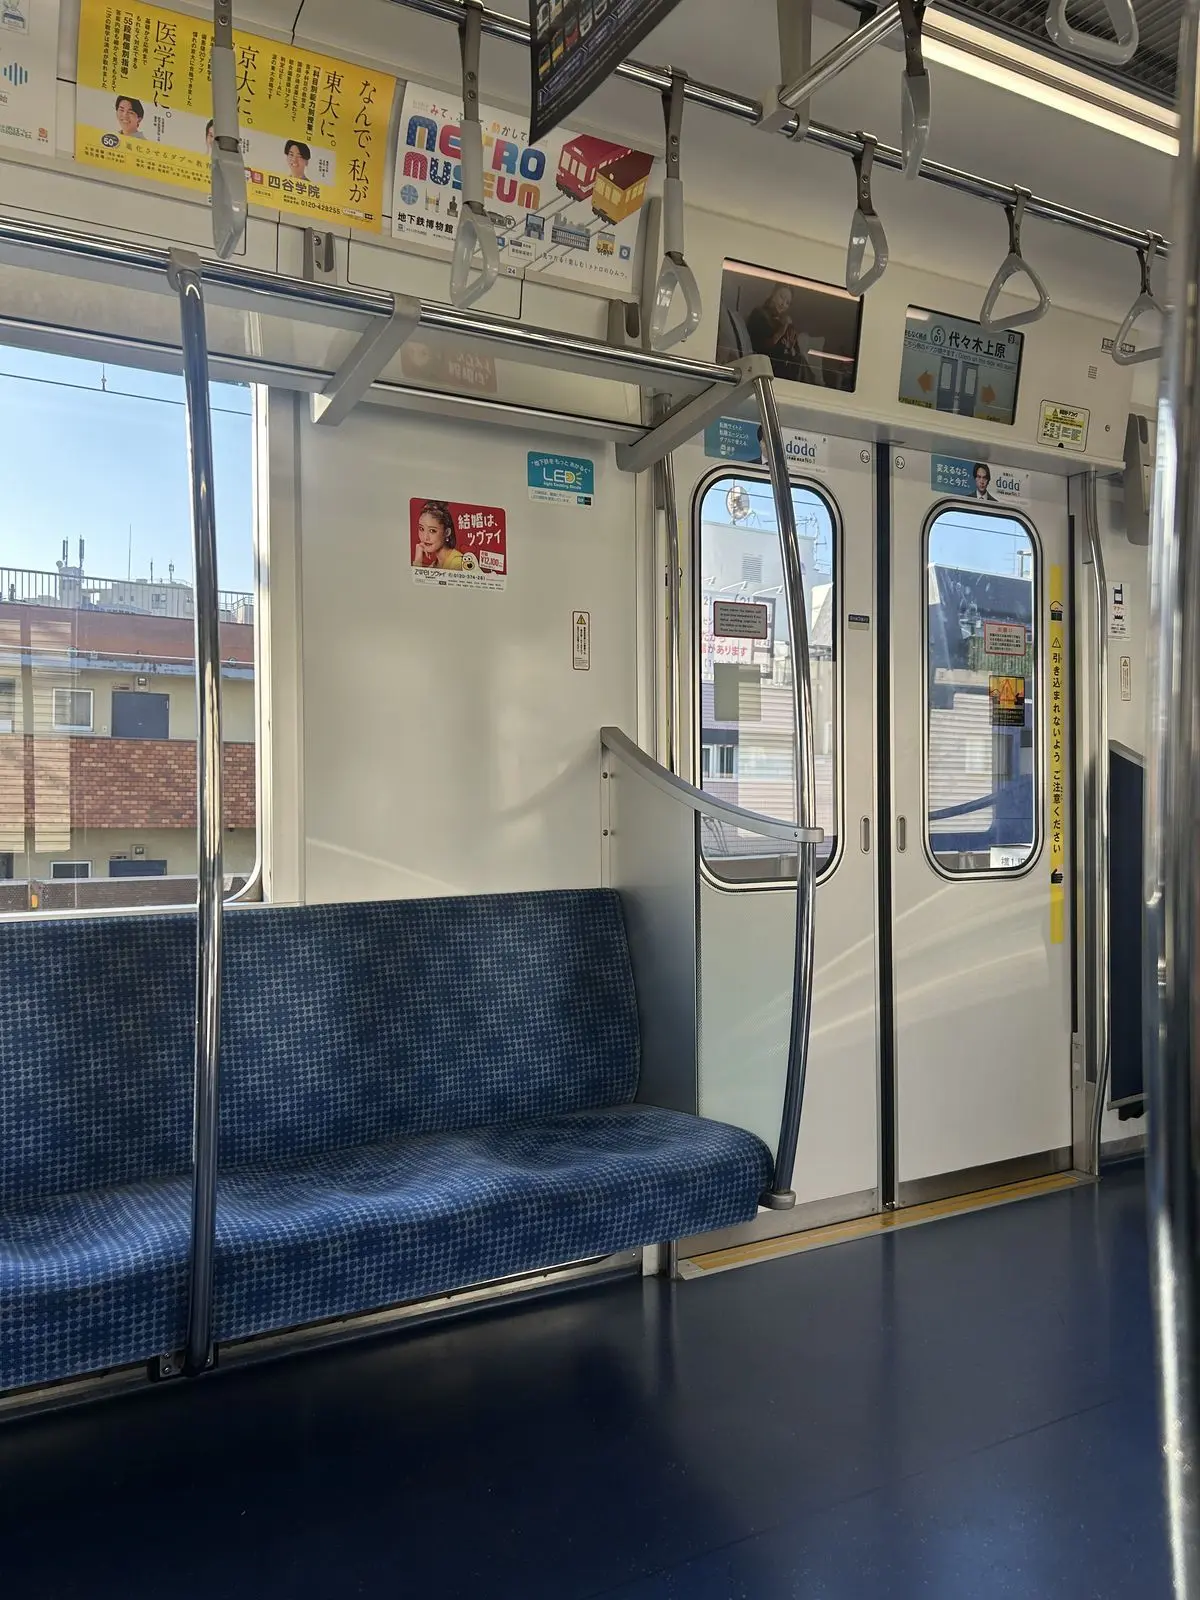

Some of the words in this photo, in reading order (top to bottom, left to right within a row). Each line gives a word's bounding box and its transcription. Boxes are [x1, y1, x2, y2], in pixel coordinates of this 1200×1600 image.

[151, 20, 177, 119] 医学部に。
[236, 46, 260, 125] 京大に。
[320, 71, 344, 147] 東大に。
[349, 80, 377, 203] なんで、私が
[268, 175, 321, 199] 四谷学院
[397, 211, 454, 234] 地下鉄博物館
[507, 267, 516, 275] 24
[949, 331, 1006, 359] 代々木上原
[786, 440, 816, 457] doda
[542, 467, 576, 484] LED
[936, 463, 970, 477] 変えるなら、
[995, 476, 1019, 491] doda
[457, 512, 499, 530] 結婚は、
[467, 529, 502, 546] ツヴァイ
[1052, 652, 1062, 764] 引き込まれないよう
[1052, 769, 1062, 854] ご注意ください
